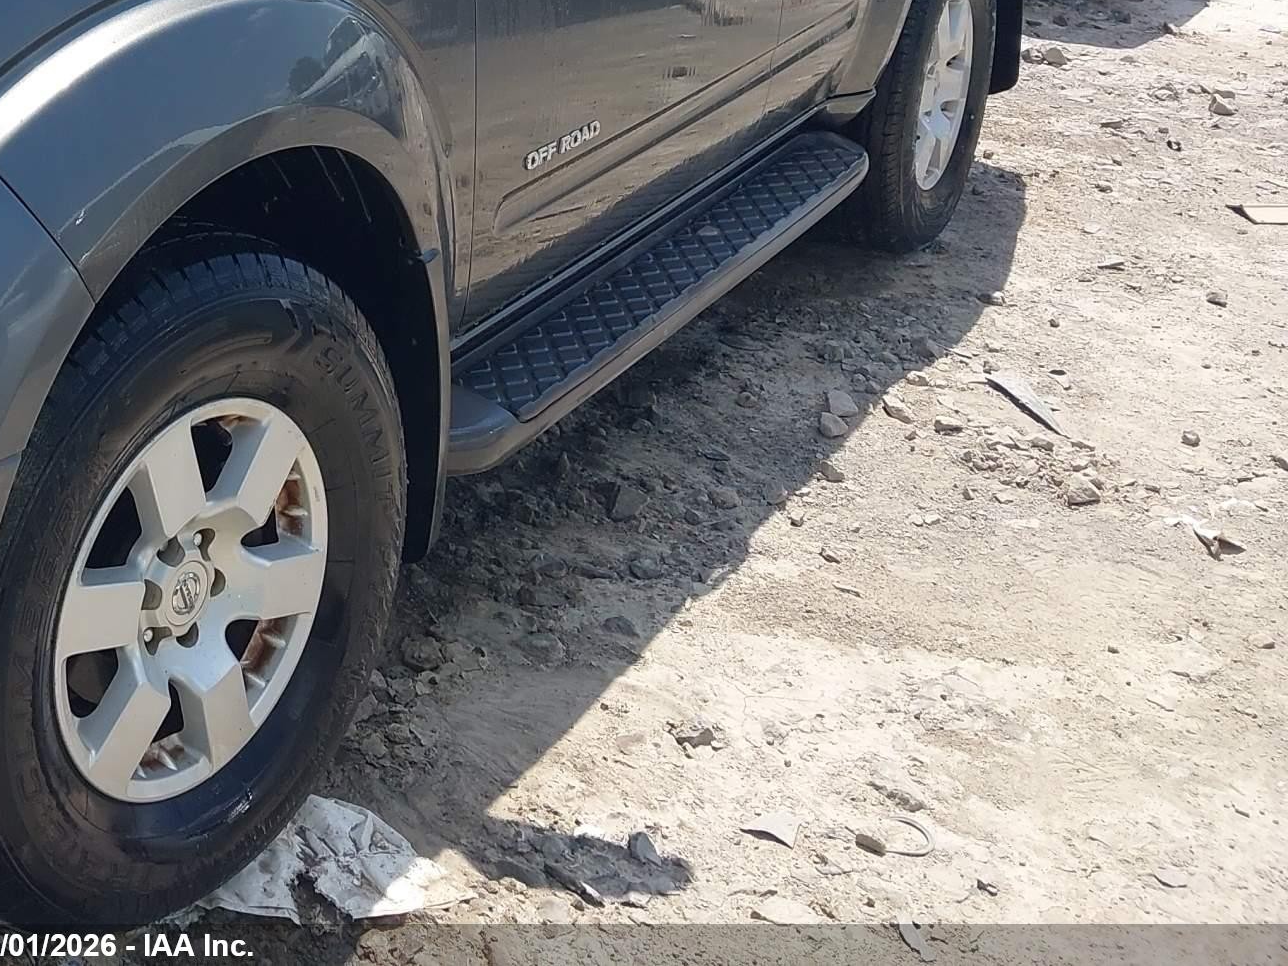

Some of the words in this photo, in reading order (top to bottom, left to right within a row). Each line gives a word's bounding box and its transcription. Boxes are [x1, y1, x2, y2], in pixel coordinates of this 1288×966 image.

[524, 141, 557, 170] OFF
[559, 120, 601, 154] ROAD
[314, 346, 396, 505] SUMMIT
